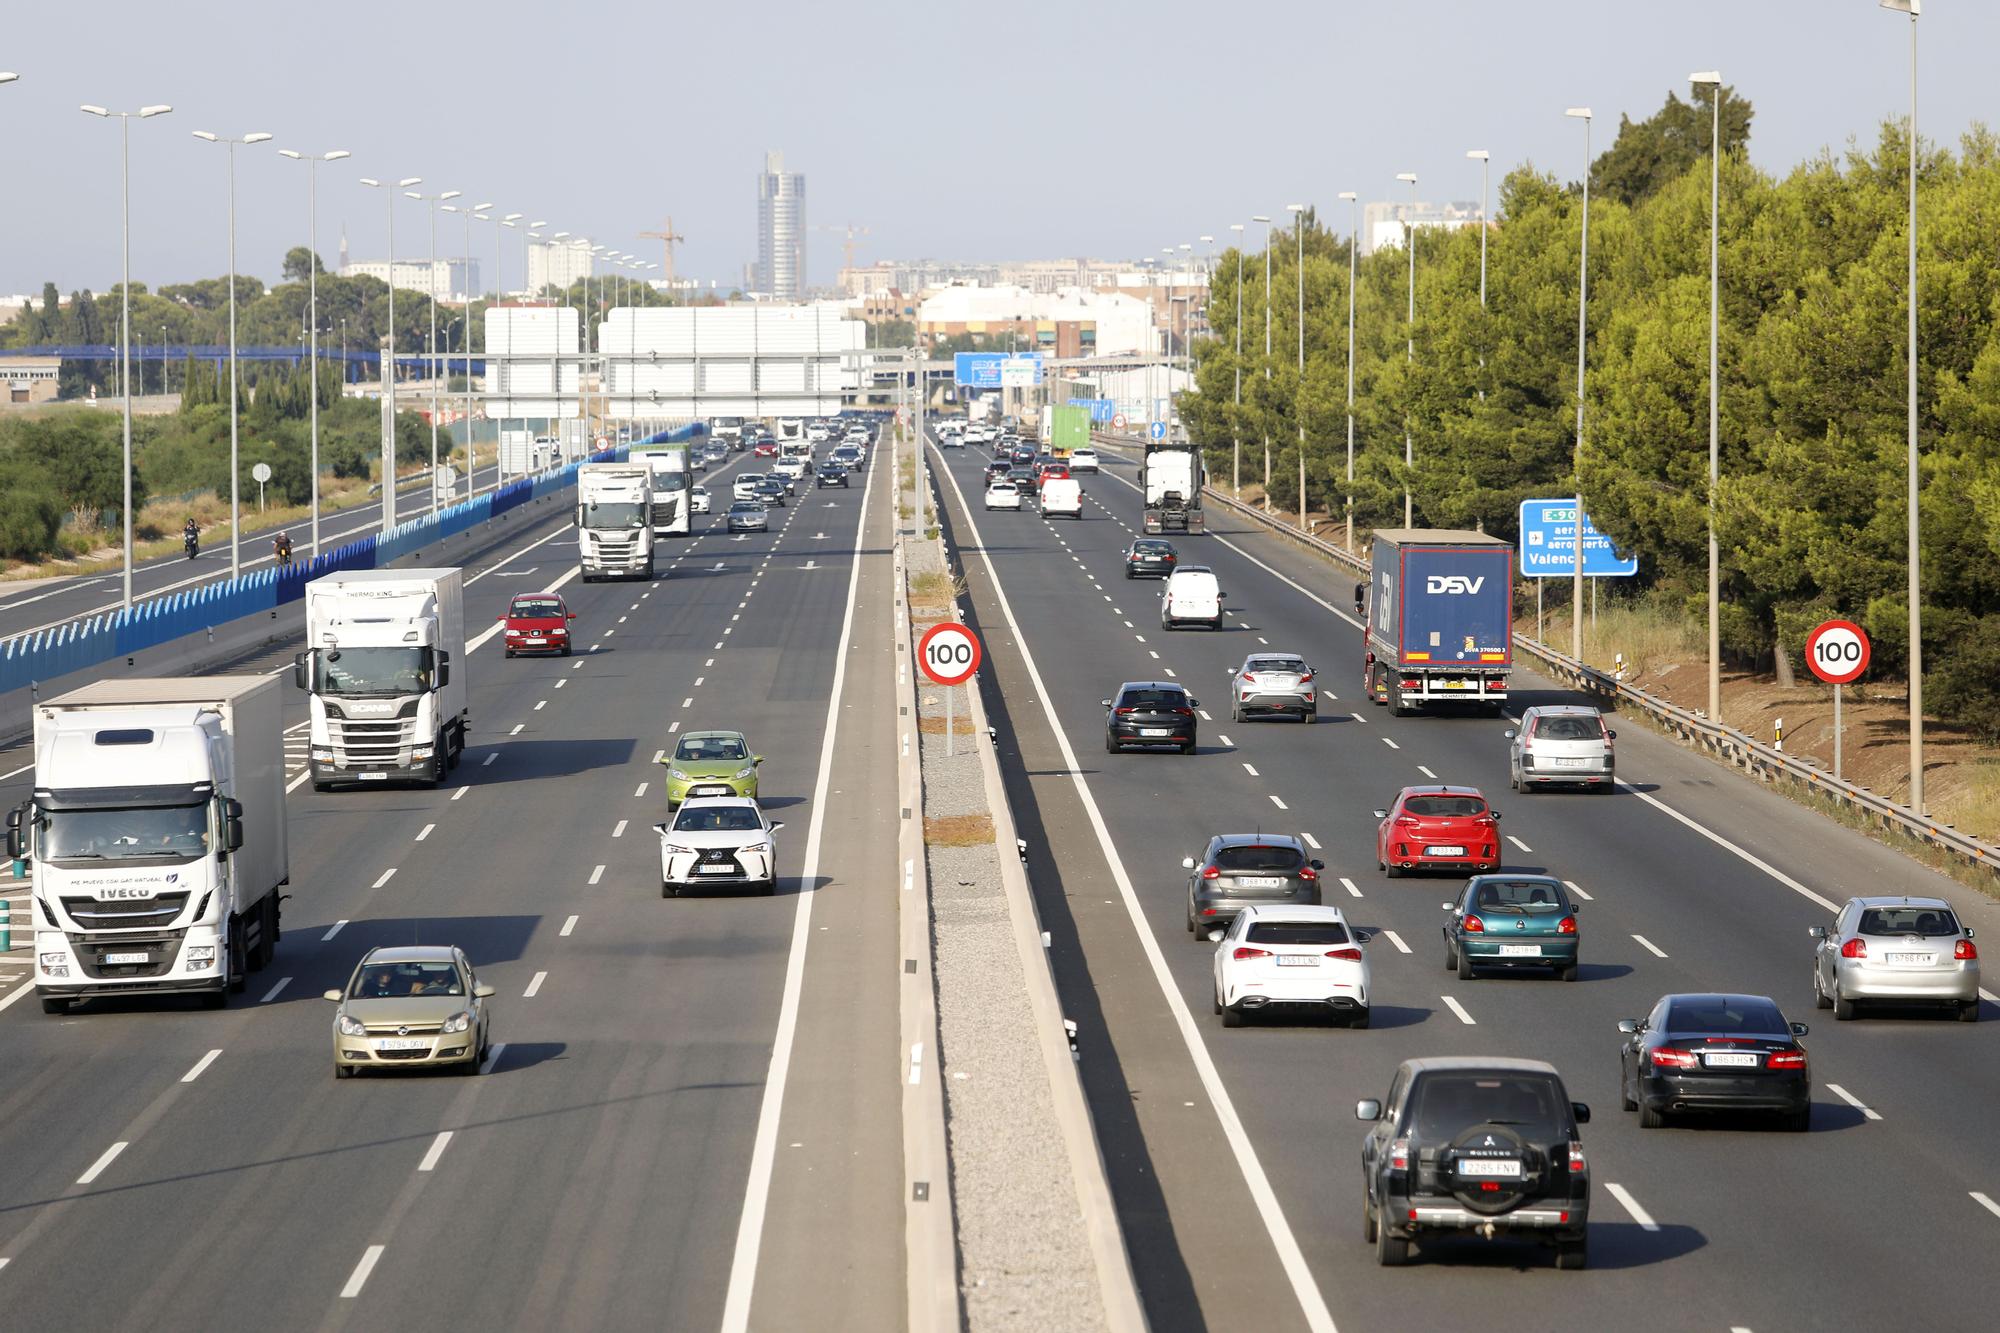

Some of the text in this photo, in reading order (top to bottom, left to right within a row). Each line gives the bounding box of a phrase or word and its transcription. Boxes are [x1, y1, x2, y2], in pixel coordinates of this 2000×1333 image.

[1427, 575, 1485, 594] DSV
[928, 643, 971, 664] 100
[1816, 641, 1860, 662] 100
[350, 704, 393, 713] SCANIA
[100, 888, 150, 899] IVECO
[1282, 956, 1300, 964] 7551
